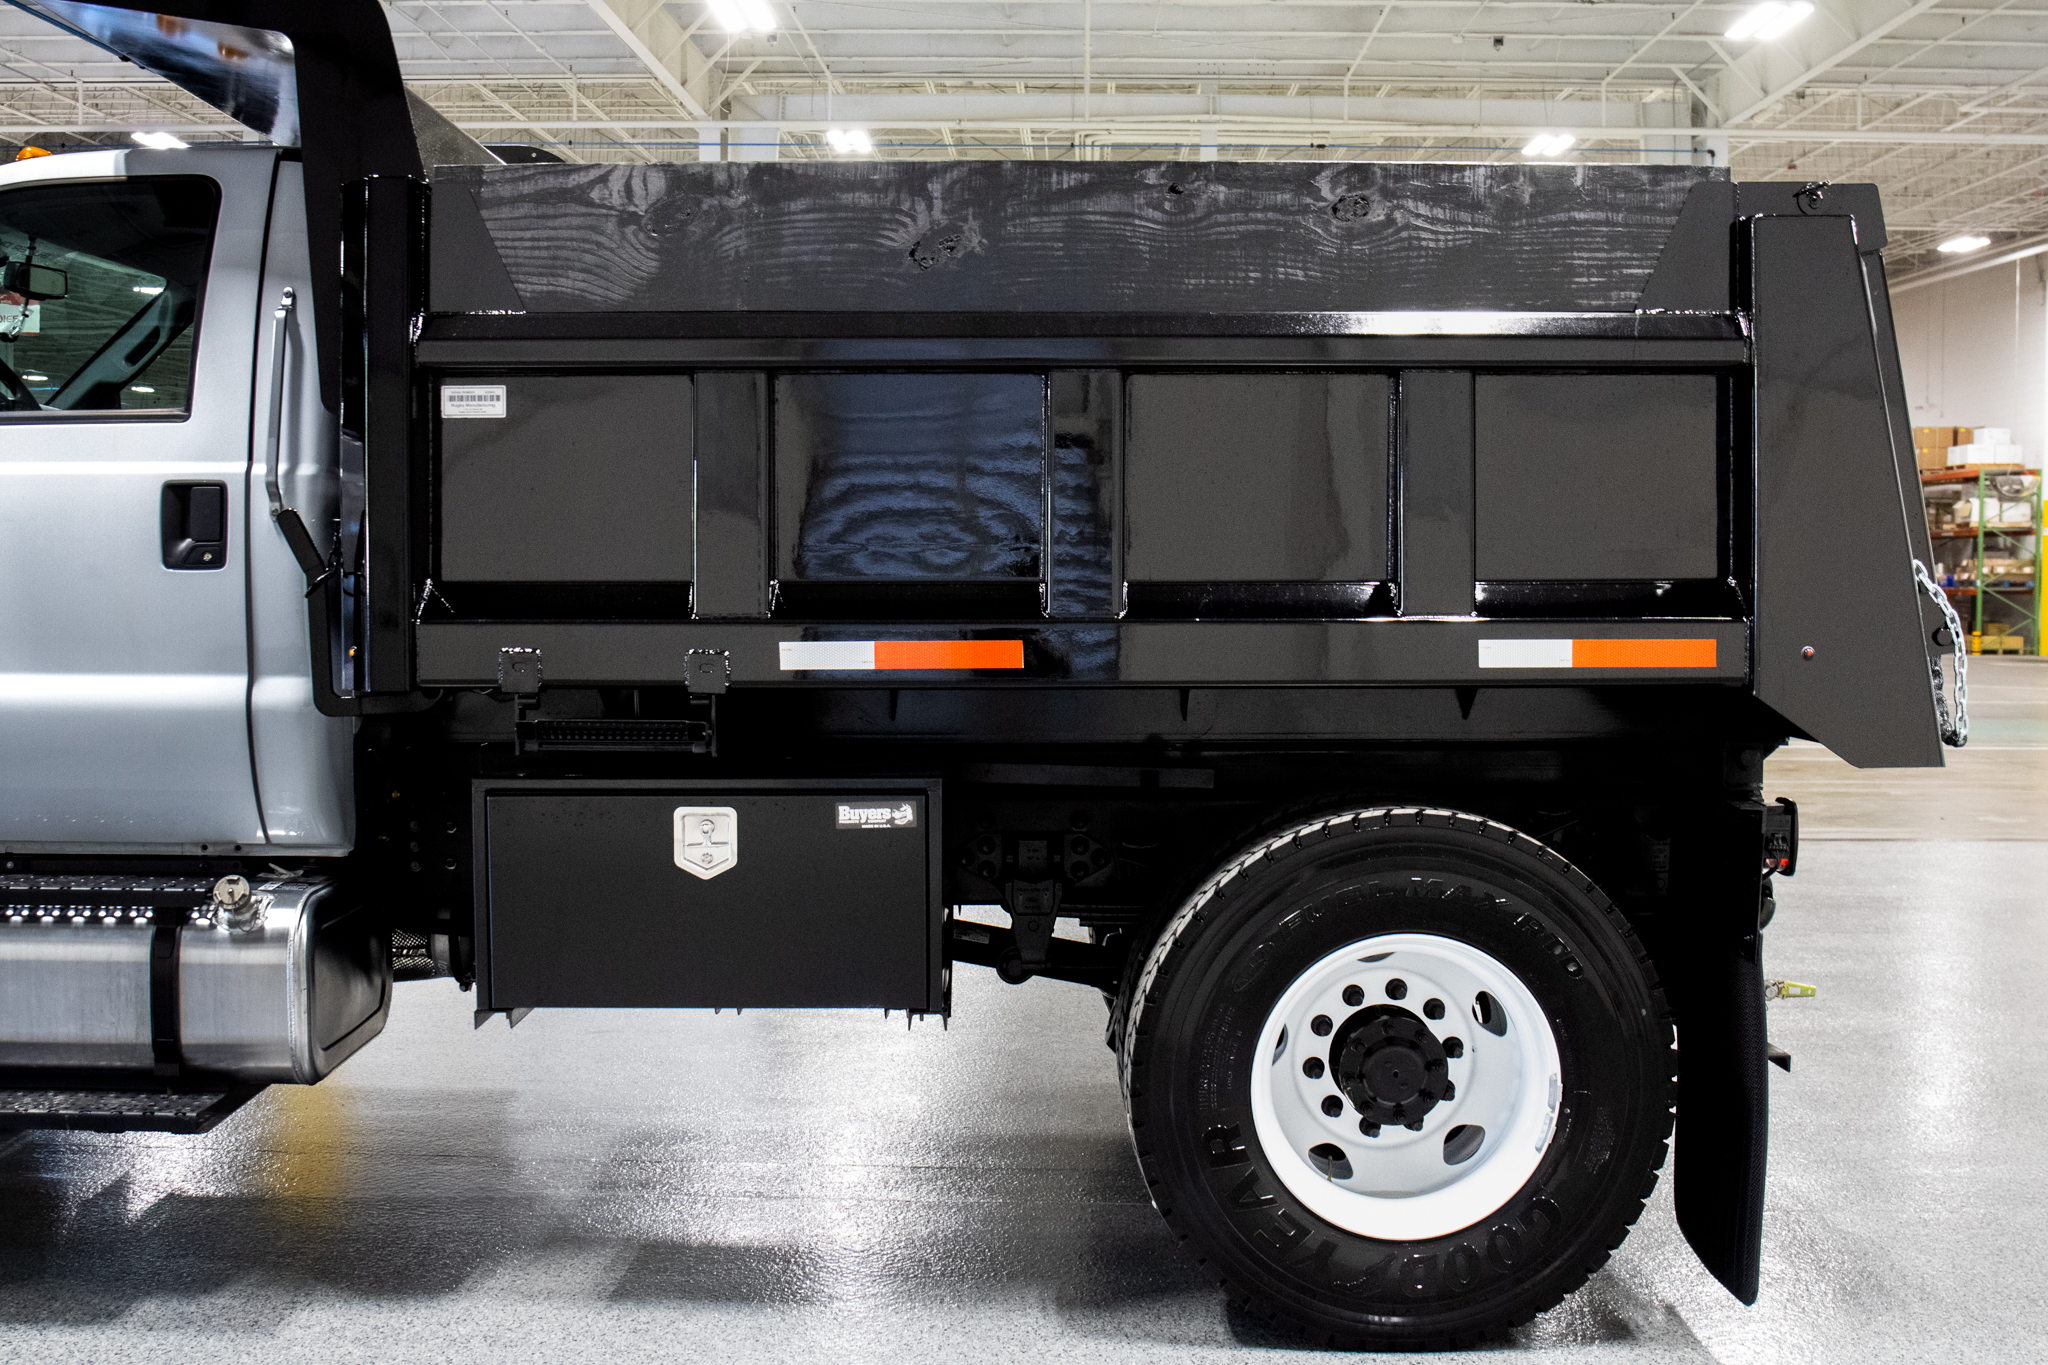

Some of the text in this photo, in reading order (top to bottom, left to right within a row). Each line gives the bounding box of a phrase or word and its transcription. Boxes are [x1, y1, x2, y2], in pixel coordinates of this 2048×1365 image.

[838, 805, 891, 823] Buyers
[1405, 877, 1512, 913] MAX
[1201, 1122, 1563, 1298] GOODYEAR
